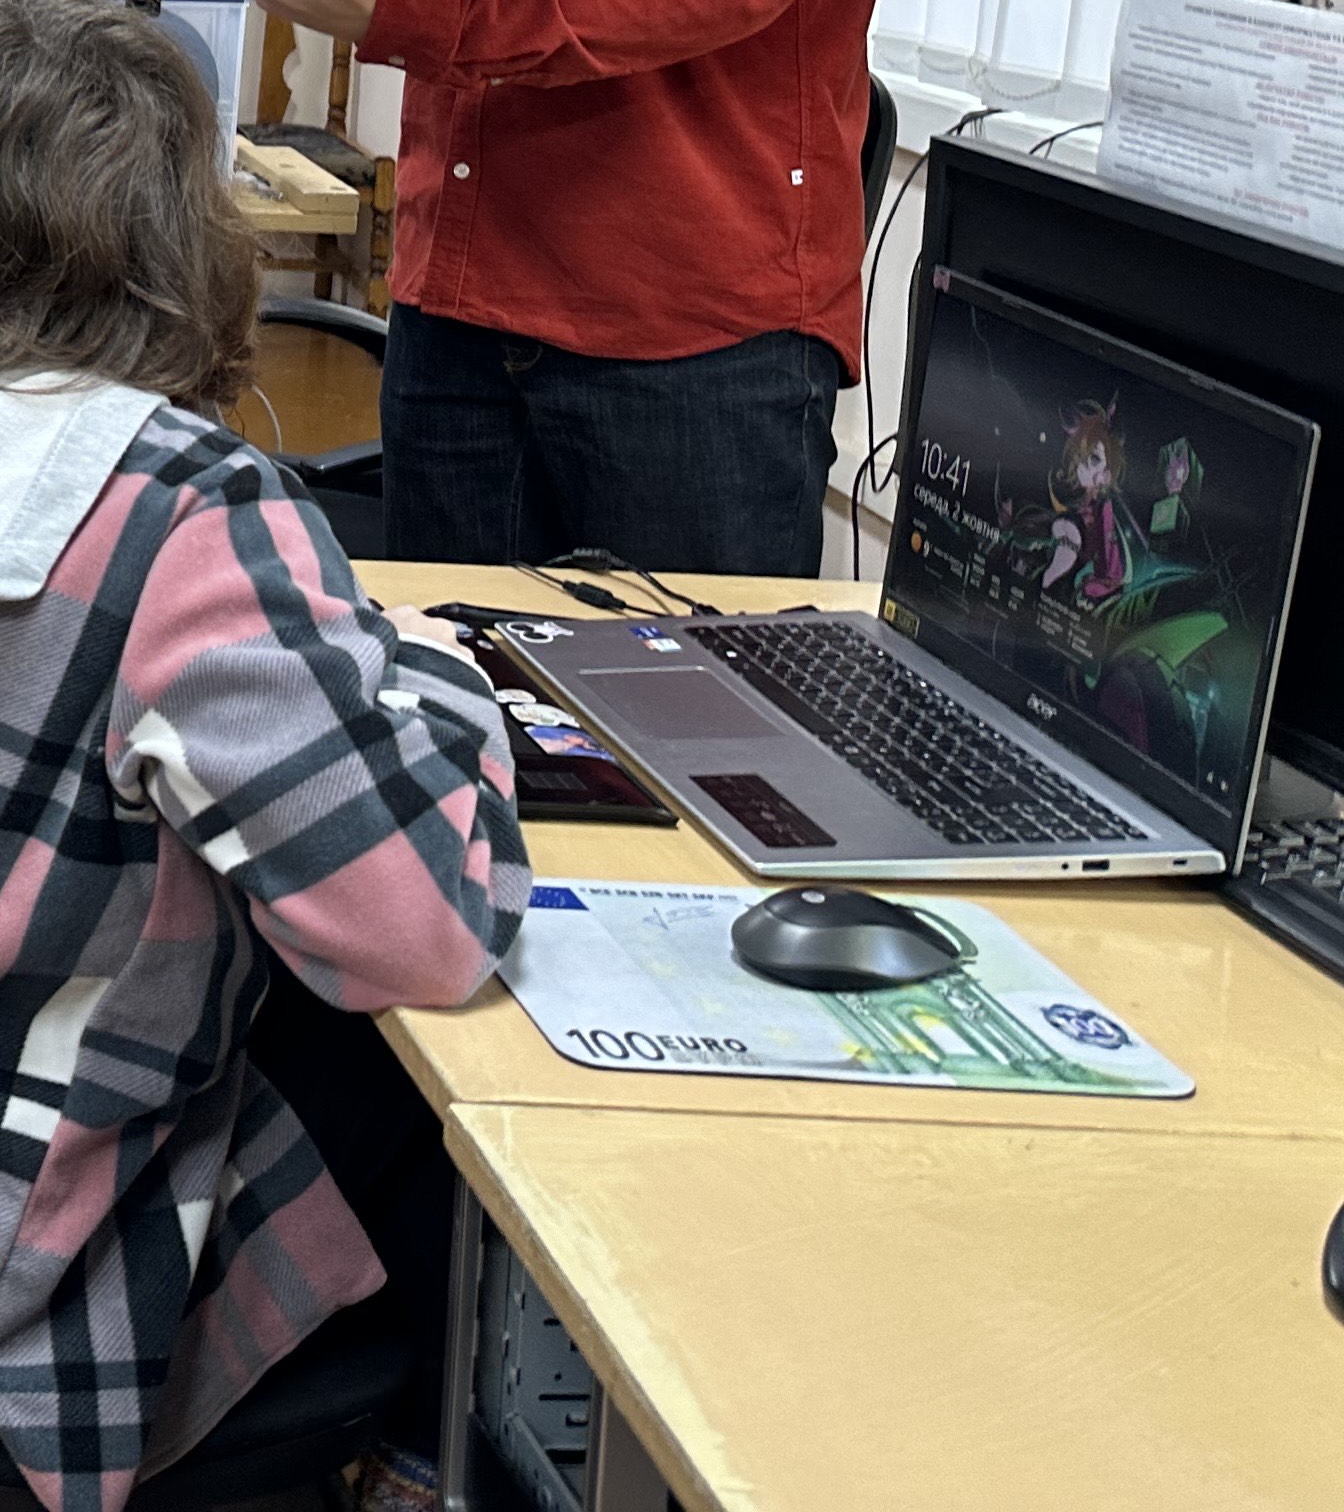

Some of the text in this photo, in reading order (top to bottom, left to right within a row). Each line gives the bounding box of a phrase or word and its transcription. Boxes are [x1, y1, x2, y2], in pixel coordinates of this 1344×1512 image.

[922, 438, 971, 498] 10:41
[952, 500, 962, 522] 2
[962, 509, 1000, 545] жовтня
[566, 1028, 748, 1061] 100 EURO
